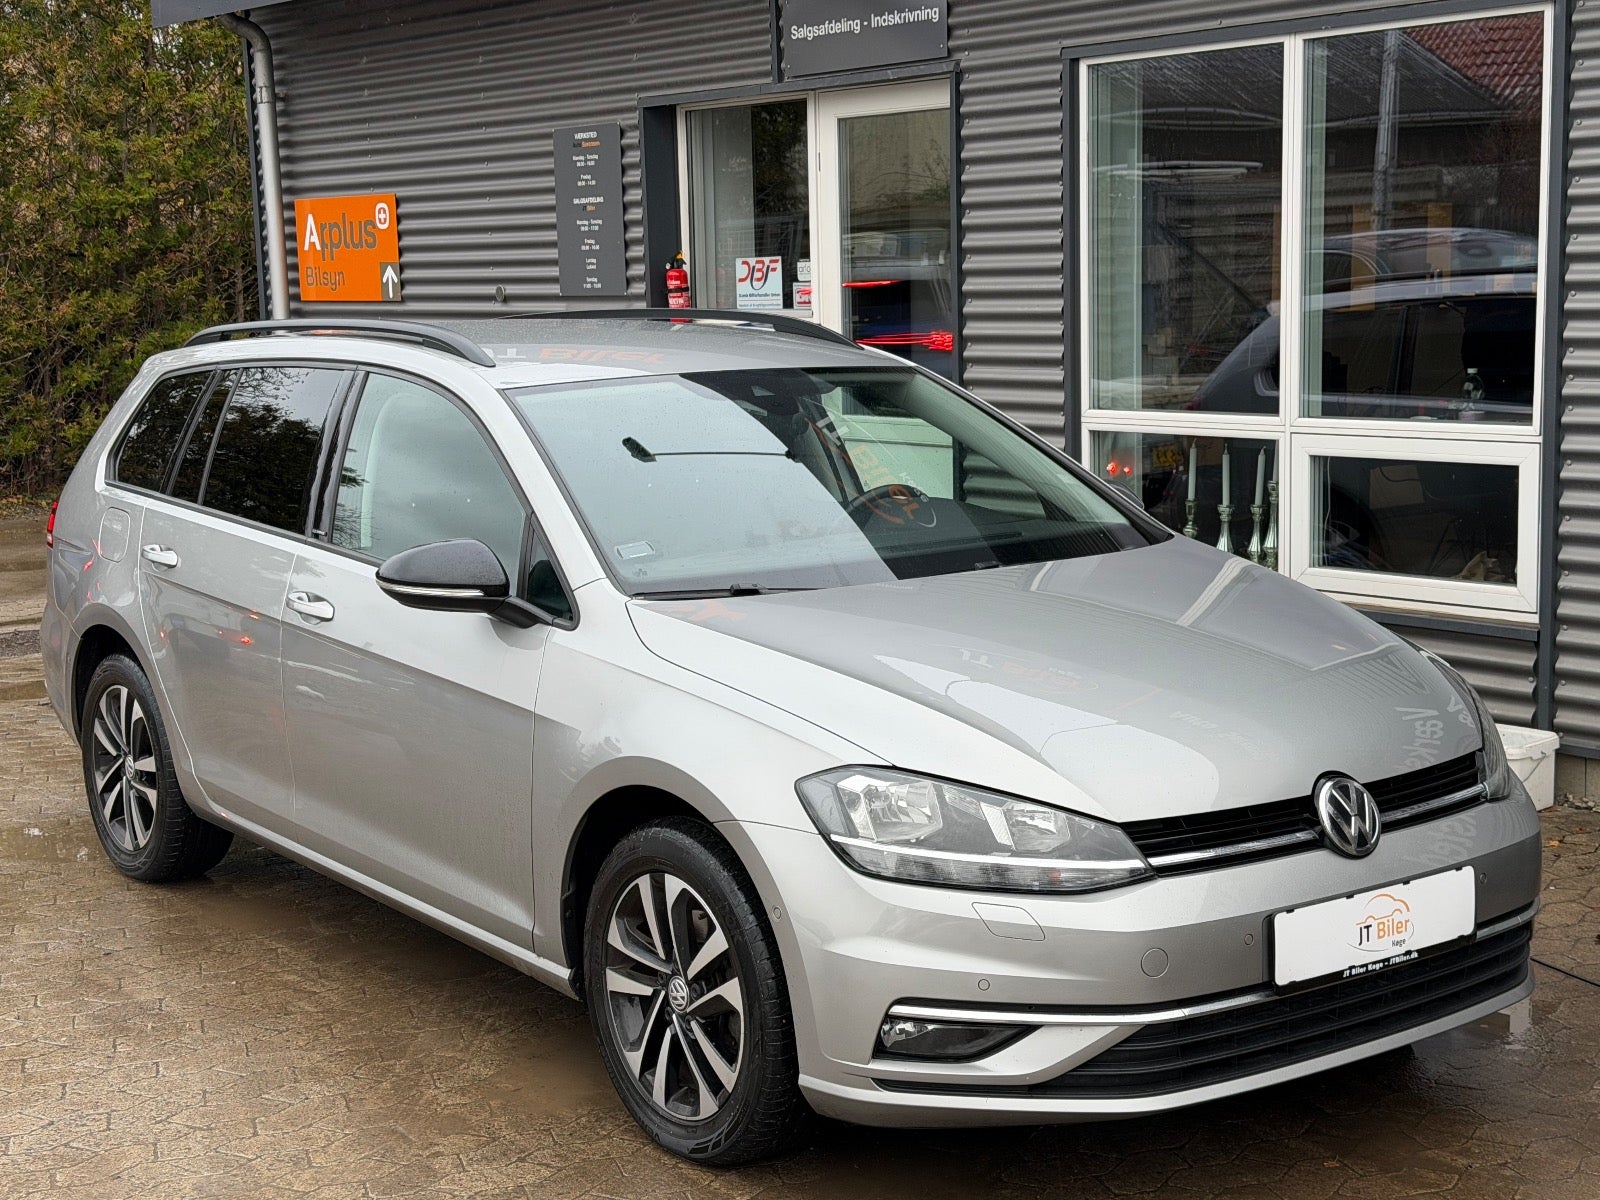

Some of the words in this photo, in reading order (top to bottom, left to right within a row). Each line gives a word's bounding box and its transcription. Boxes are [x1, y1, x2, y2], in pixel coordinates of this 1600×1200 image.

[791, 18, 861, 40] Salgsafdeling
[871, 6, 939, 29] Indskrivning
[305, 266, 346, 292] Bilsyn
[1358, 924, 1373, 947] JT
[1376, 918, 1410, 940] Biler
[1352, 966, 1366, 975] Biler
